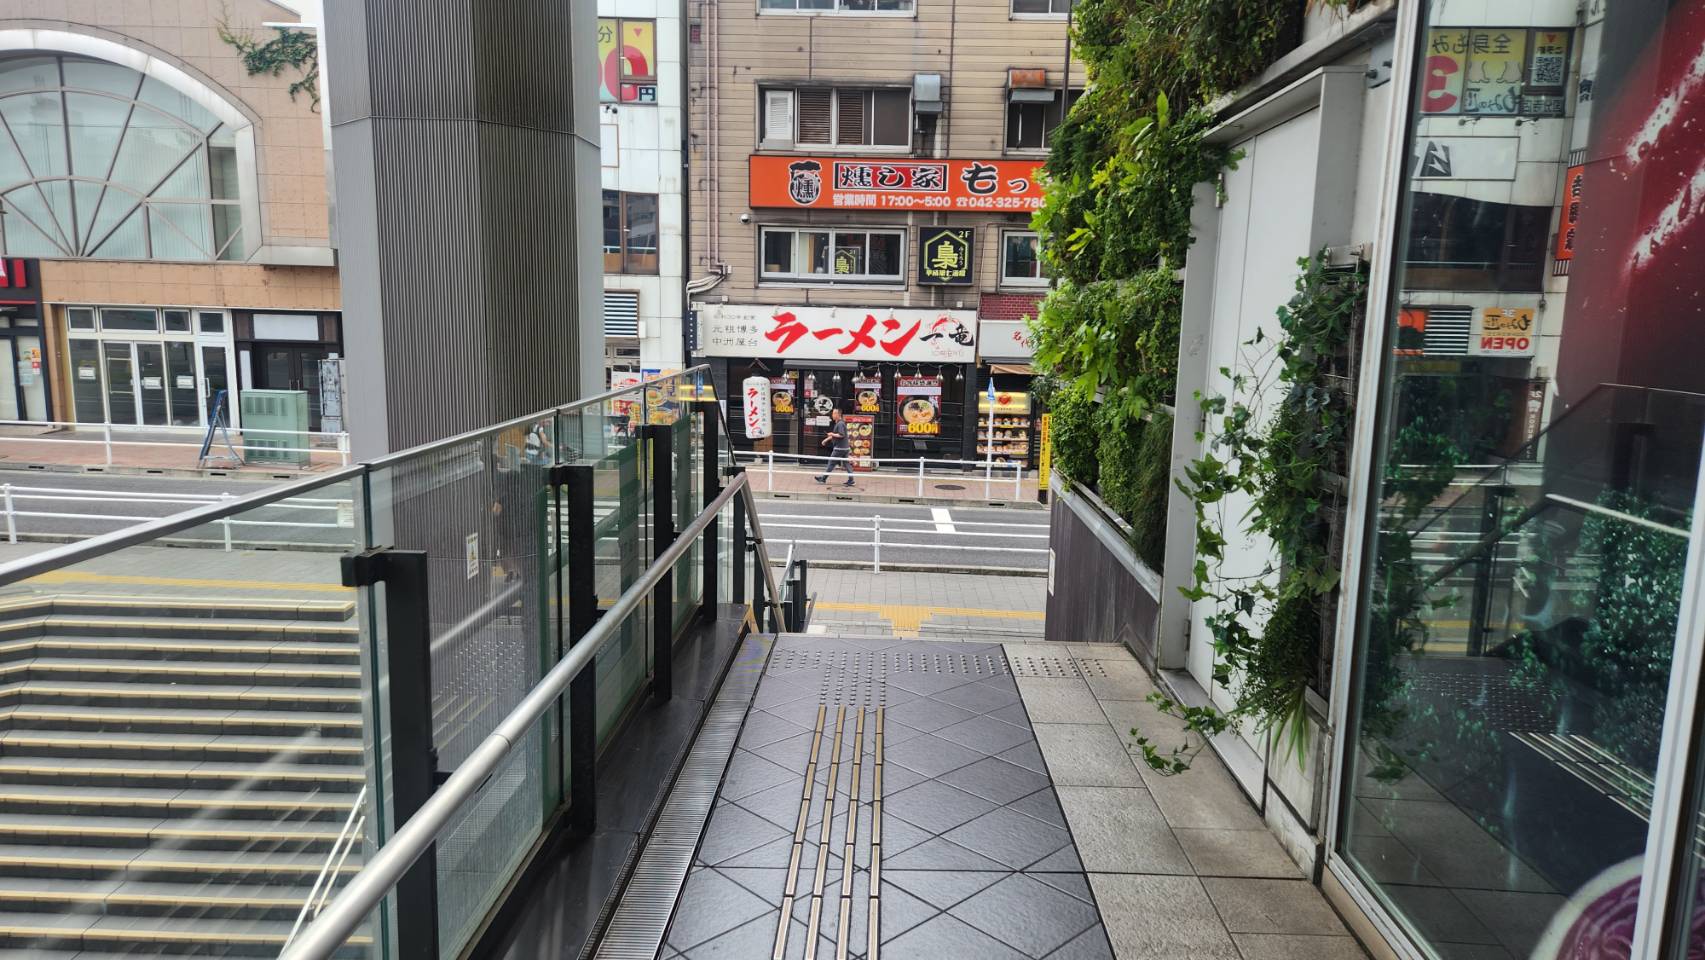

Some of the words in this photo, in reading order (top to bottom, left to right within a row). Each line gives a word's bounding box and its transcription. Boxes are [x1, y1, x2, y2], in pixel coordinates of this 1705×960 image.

[598, 26, 613, 43] 分
[833, 193, 877, 207] 営業時間
[958, 230, 971, 238] 2F
[931, 241, 959, 269] 梟
[712, 324, 758, 334] 元祖博多
[764, 311, 921, 356] ラーメン
[712, 337, 758, 347] 中洲屋台
[747, 388, 760, 428] ラーメン
